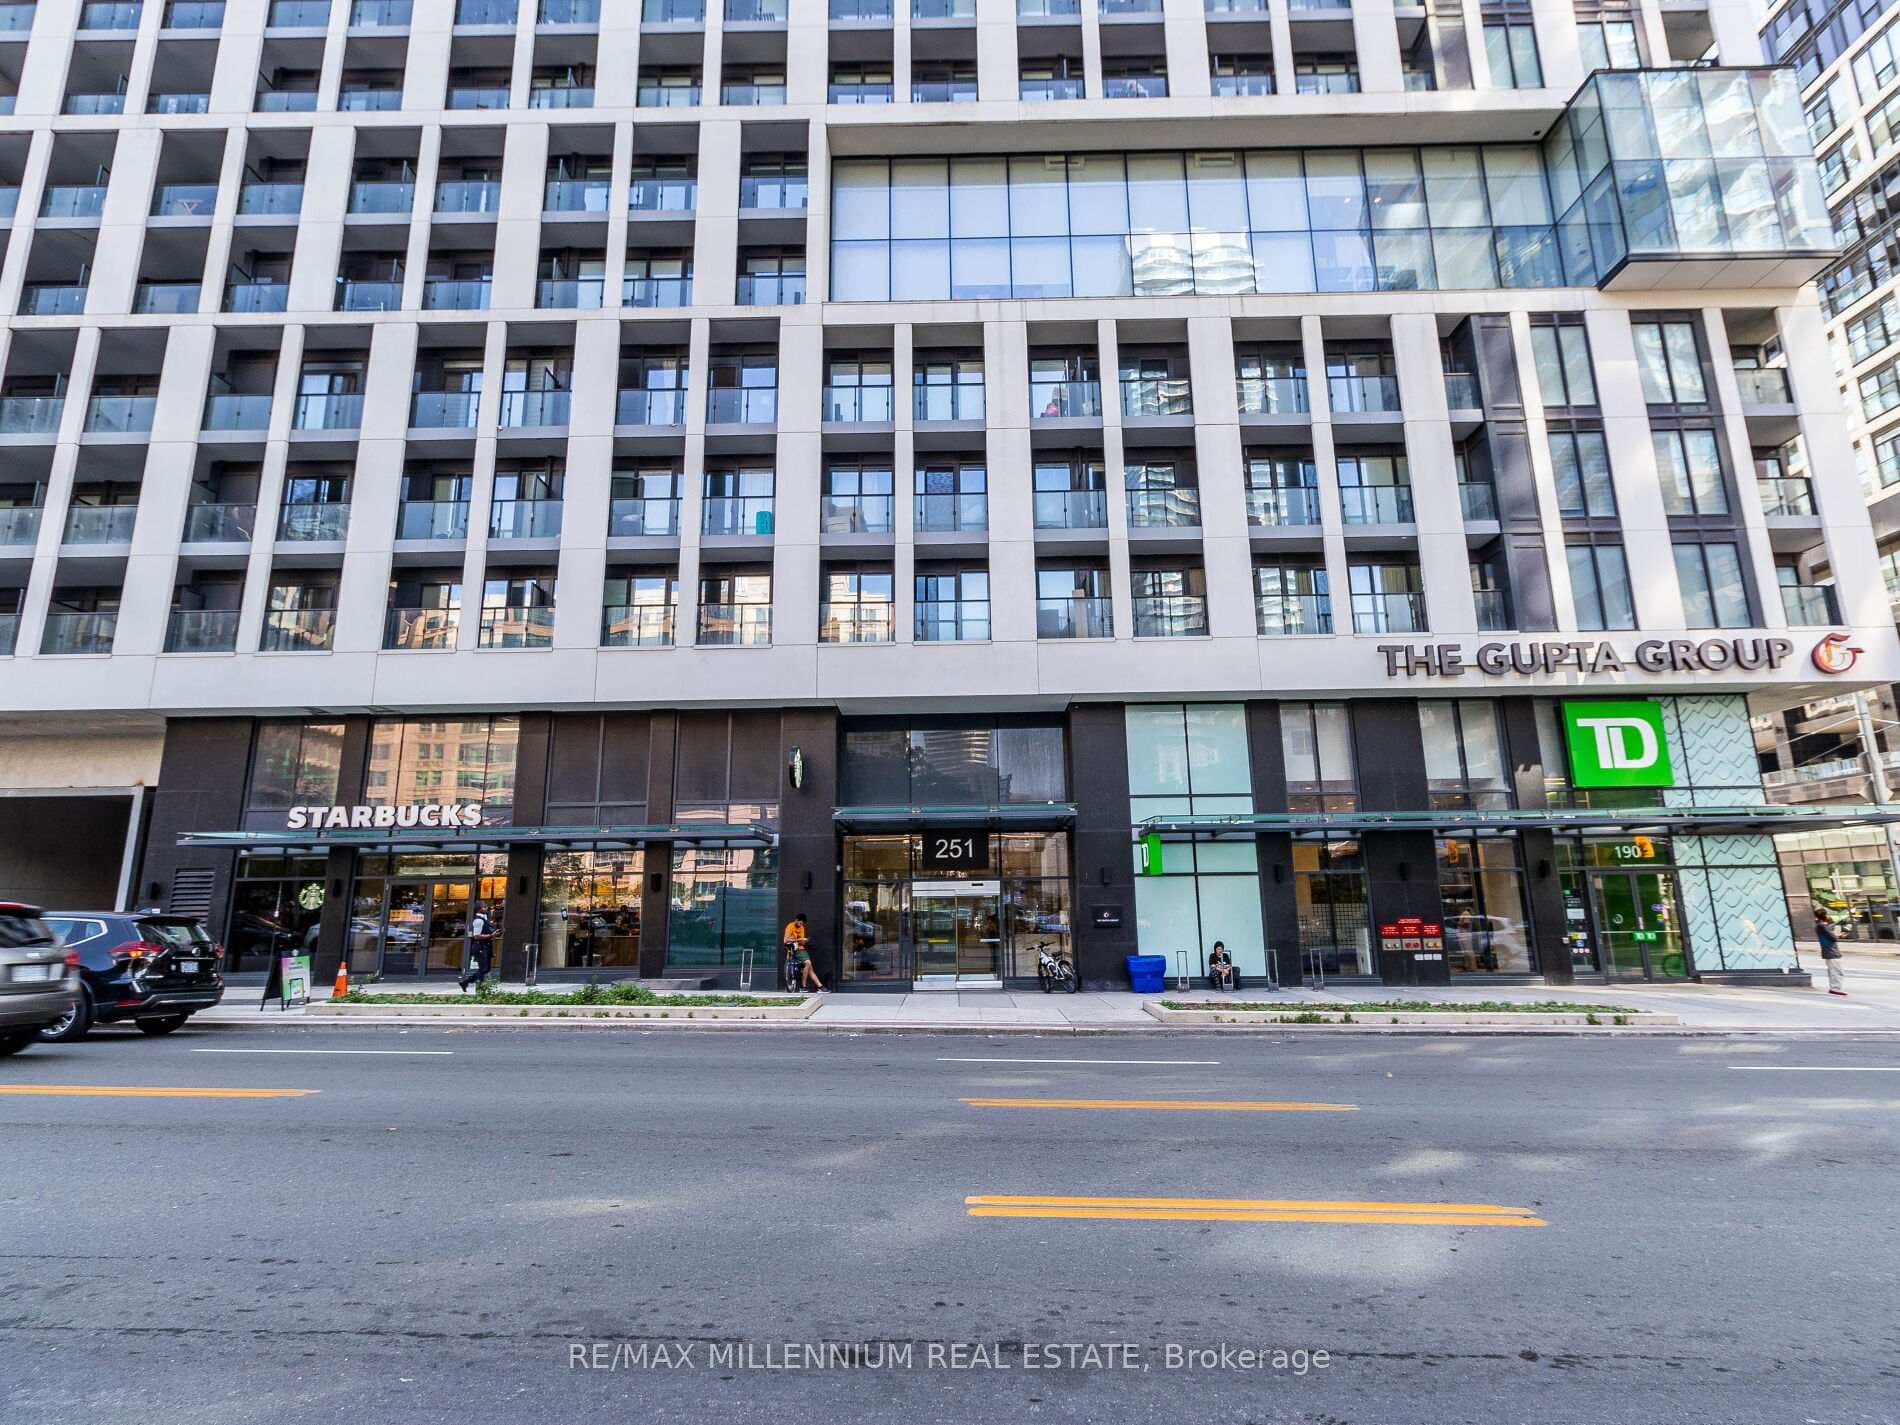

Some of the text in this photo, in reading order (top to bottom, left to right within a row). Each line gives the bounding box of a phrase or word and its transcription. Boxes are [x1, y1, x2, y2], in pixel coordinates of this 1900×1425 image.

[1377, 637, 1795, 677] THE GUPTA GROUP
[1576, 717, 1659, 769] TD
[287, 804, 482, 829] STARBUCKS
[935, 839, 975, 859] 251
[1614, 845, 1640, 859] 190
